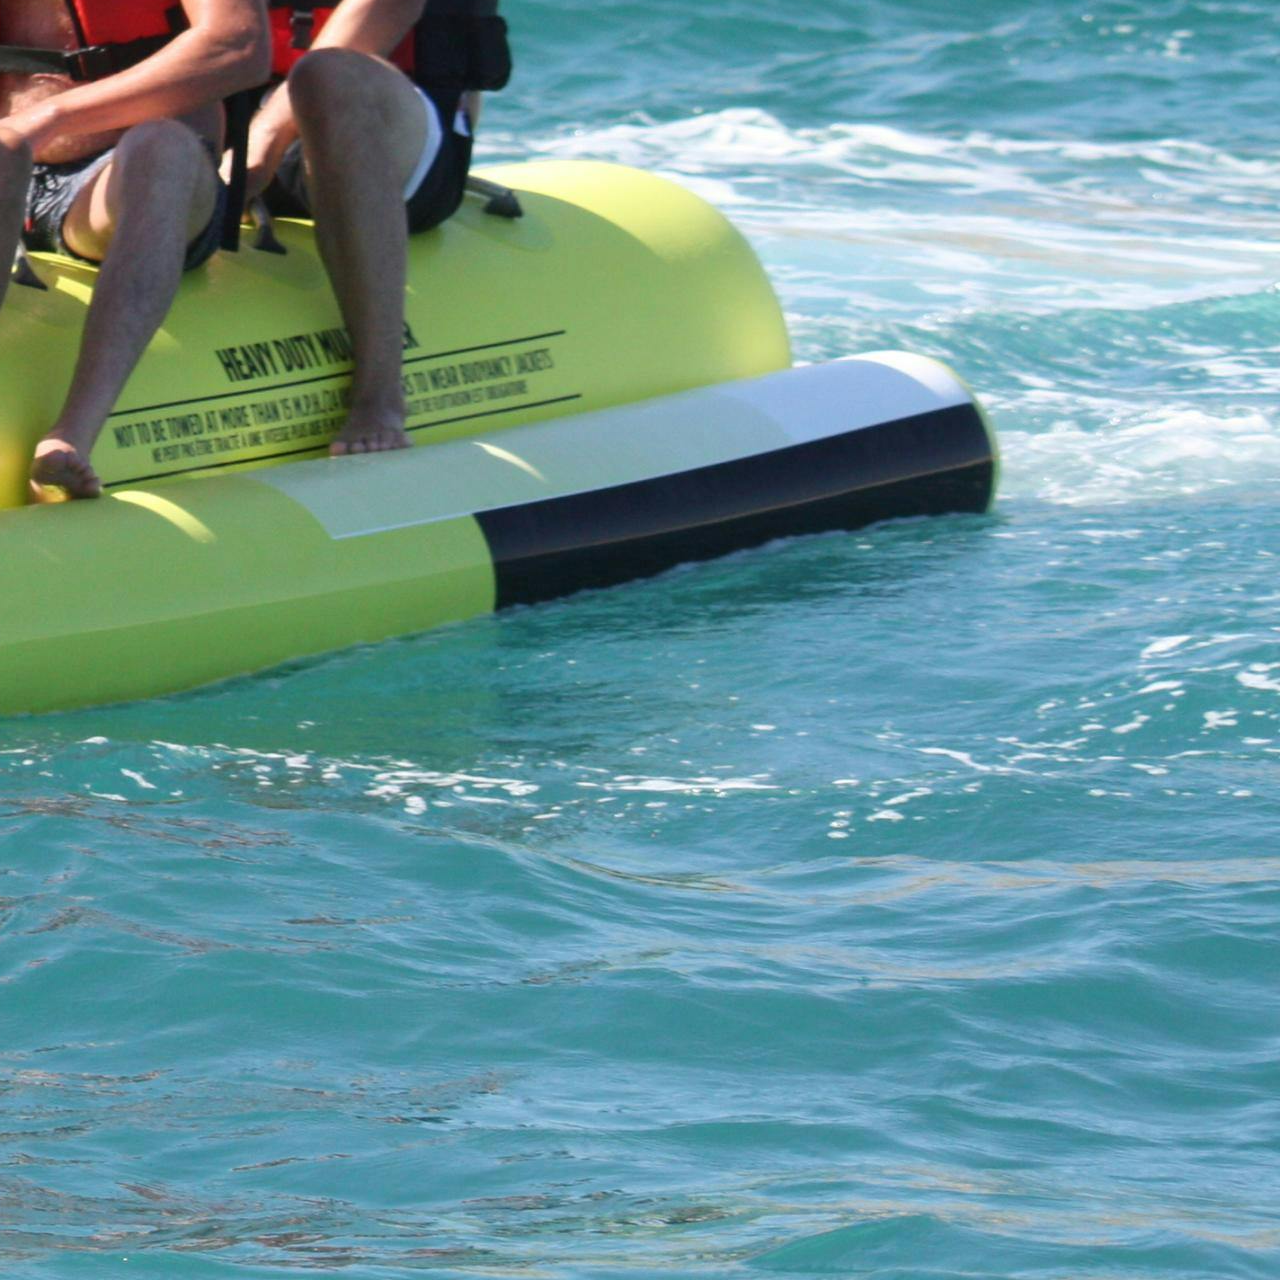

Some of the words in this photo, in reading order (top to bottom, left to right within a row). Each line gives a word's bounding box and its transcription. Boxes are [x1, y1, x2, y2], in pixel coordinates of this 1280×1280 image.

[215, 342, 279, 383] HEAVY
[272, 333, 322, 373] DUTY
[113, 424, 136, 448] NOT
[135, 422, 152, 445] TO
[150, 419, 167, 443] BE
[165, 413, 204, 440] TOWED
[204, 410, 220, 434] AT
[219, 405, 251, 431] MORE
[250, 400, 281, 425] THAN
[413, 371, 429, 394] TO
[428, 365, 461, 390] WEAR
[458, 356, 515, 385] BUOYANCY
[514, 347, 555, 375] JACKETS
